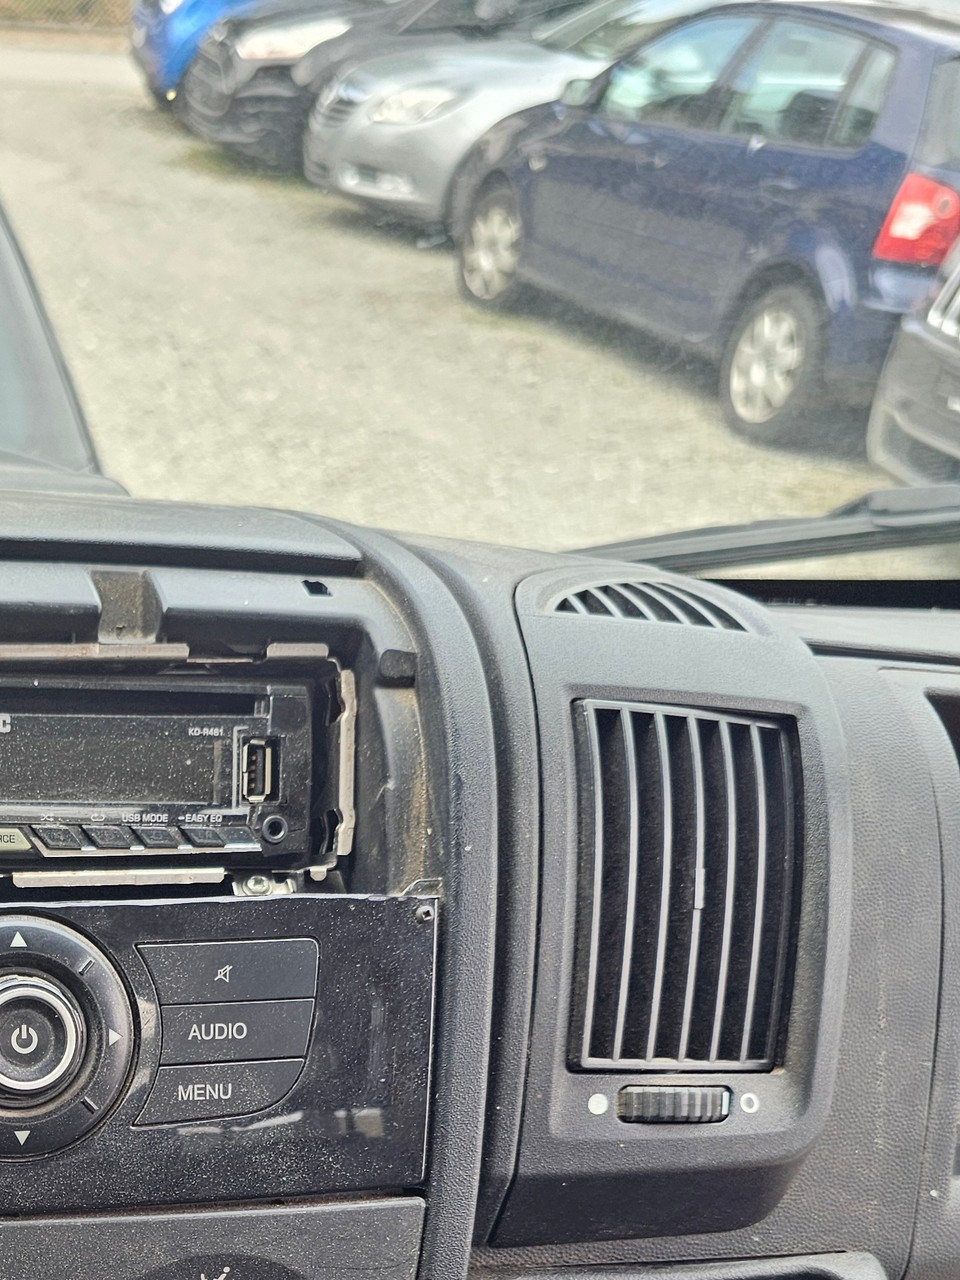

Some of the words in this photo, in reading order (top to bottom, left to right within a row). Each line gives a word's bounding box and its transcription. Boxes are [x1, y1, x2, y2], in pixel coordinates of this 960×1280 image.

[121, 814, 140, 822] USB
[142, 814, 169, 822] MODE
[185, 814, 209, 822] EASY
[209, 814, 223, 823] EQ
[187, 1022, 248, 1042] AUDIO
[177, 1082, 233, 1103] MENU
